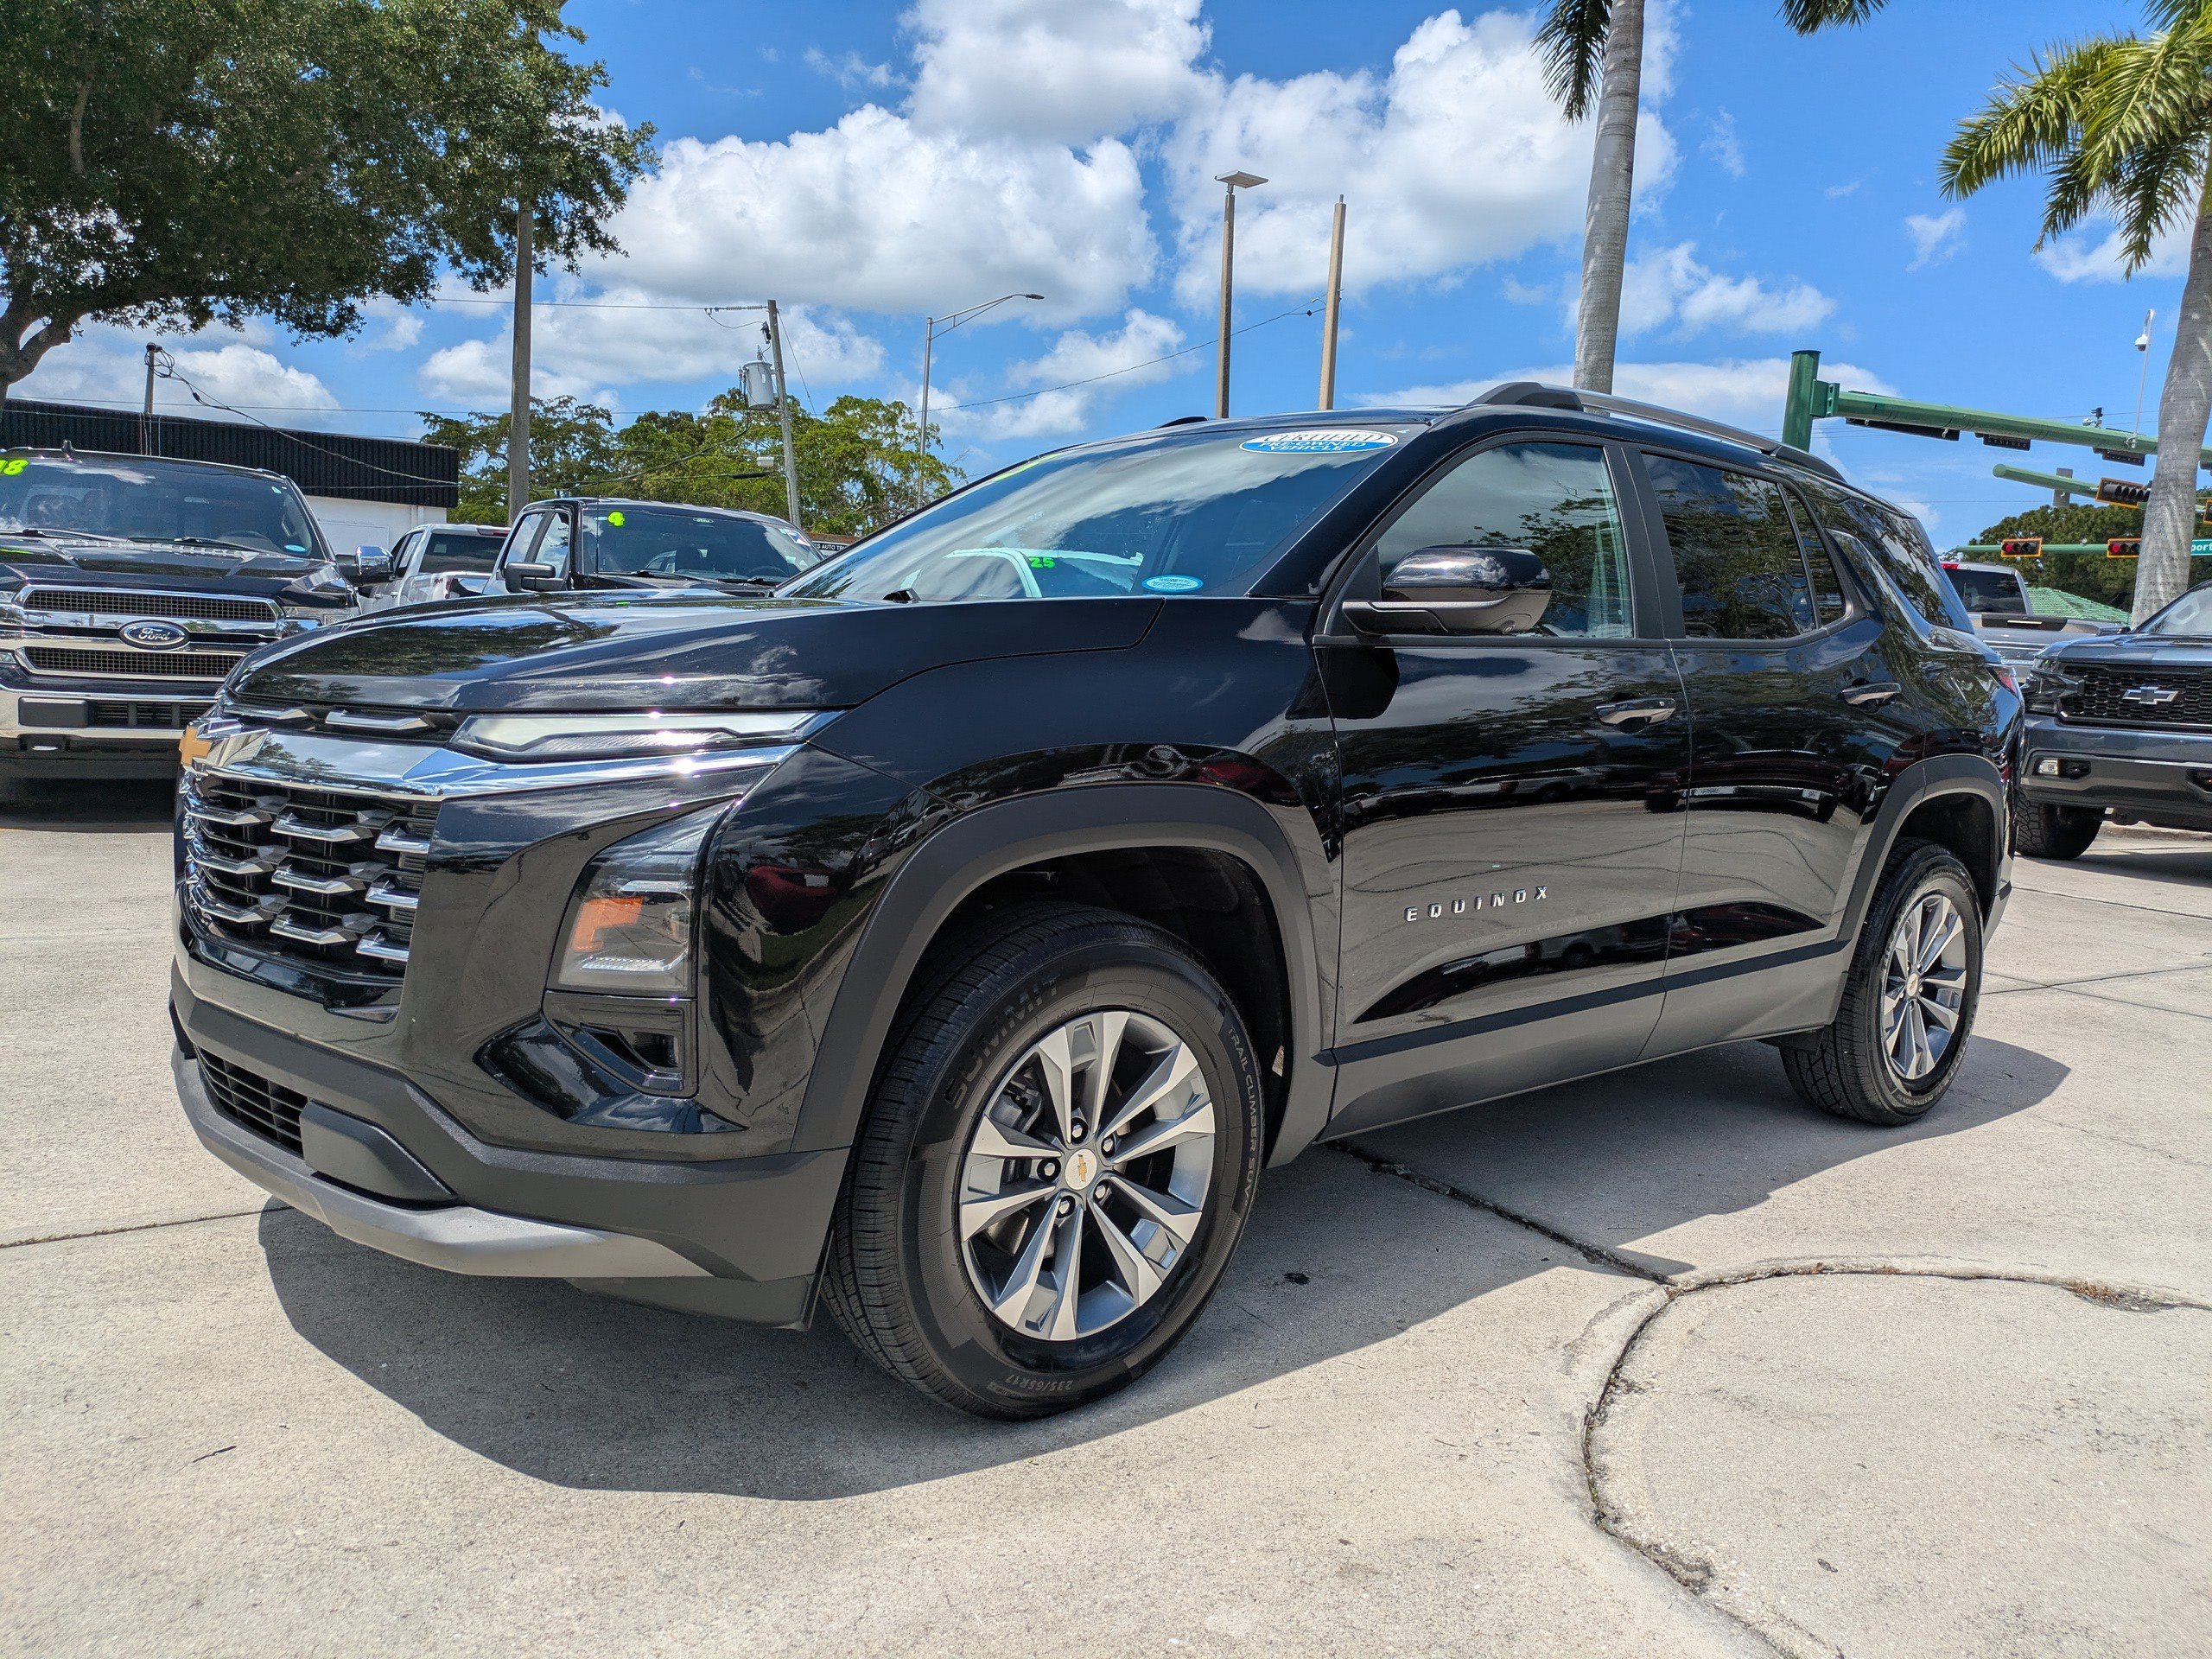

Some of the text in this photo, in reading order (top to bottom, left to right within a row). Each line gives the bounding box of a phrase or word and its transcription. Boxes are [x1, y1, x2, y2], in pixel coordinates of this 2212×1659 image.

[1028, 556, 1056, 569] 25
[138, 627, 171, 641] Ford
[1404, 885, 1548, 922] EQUINOX
[944, 972, 1062, 1110] SUMMIT
[1227, 1025, 1250, 1072] TRAIL
[1244, 1073, 1259, 1153] CLIMBER
